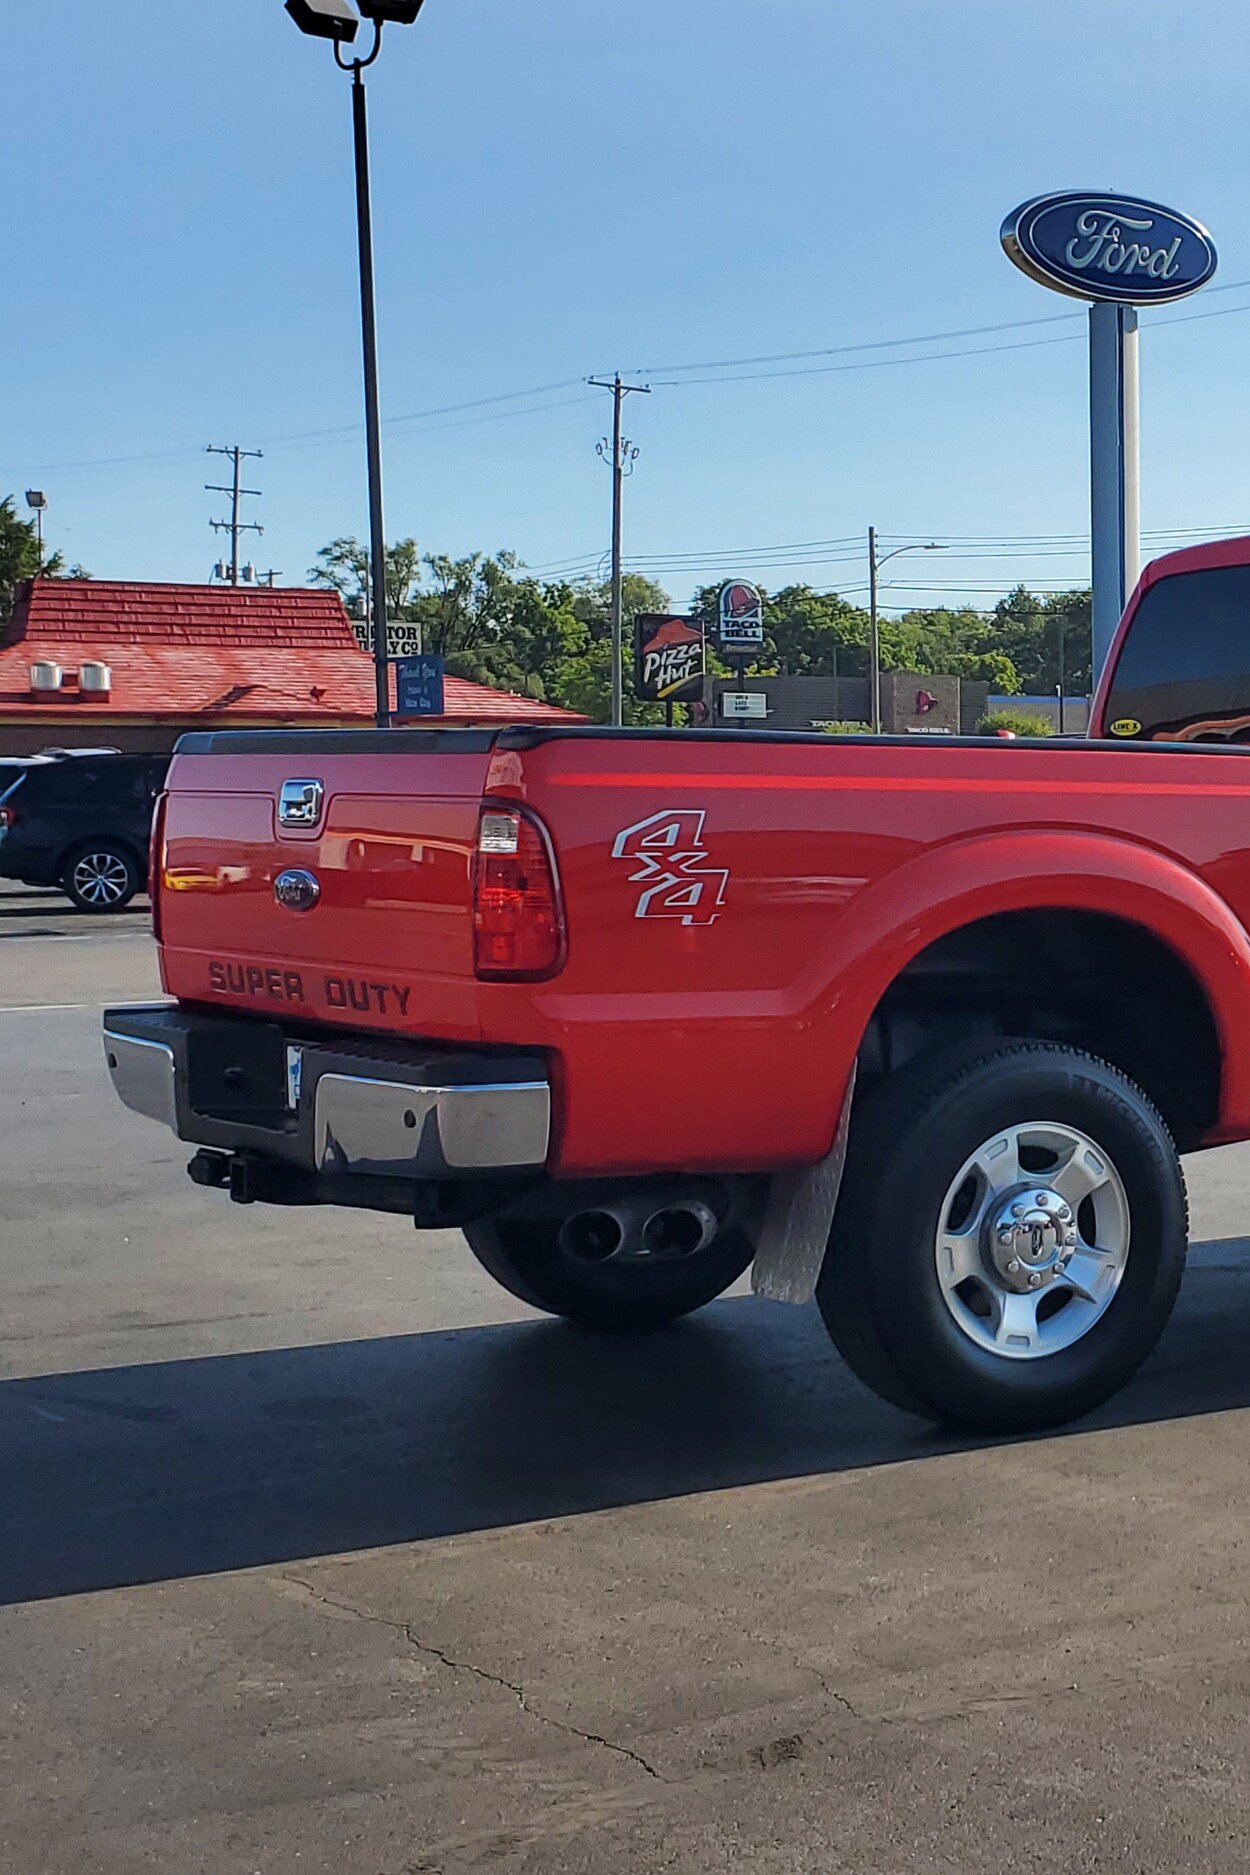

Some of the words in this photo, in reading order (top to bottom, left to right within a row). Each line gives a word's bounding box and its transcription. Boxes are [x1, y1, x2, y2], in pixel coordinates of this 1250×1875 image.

[1065, 209, 1182, 280] Ford
[723, 620, 760, 629] TACO
[725, 630, 761, 638] BELL
[643, 643, 703, 683] Pizza
[655, 659, 698, 690] Hut
[209, 961, 304, 1002] SUPER
[324, 975, 410, 1016] DUTY
